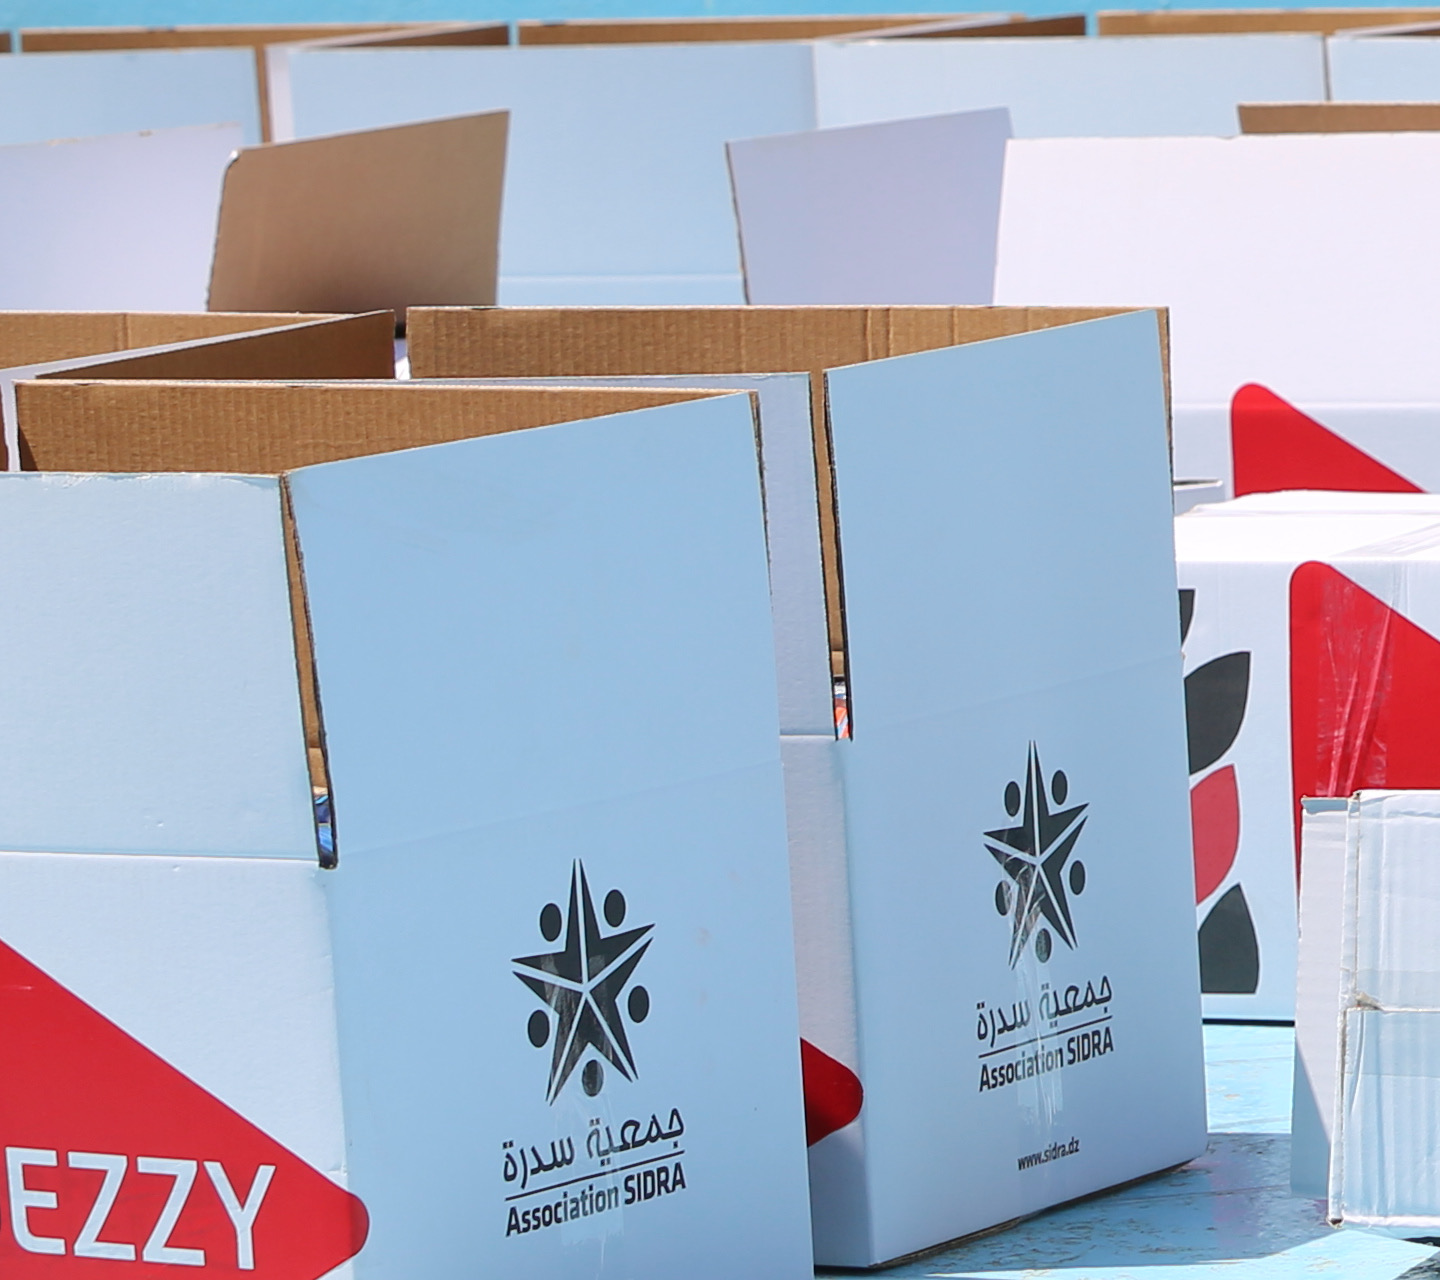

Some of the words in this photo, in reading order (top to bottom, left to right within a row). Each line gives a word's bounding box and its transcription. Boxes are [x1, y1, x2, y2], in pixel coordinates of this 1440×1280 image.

[976, 1001, 1031, 1048] سدرة
[1038, 975, 1113, 1028] جمعية
[978, 1044, 1065, 1093] Association
[1066, 1026, 1114, 1067] SIDRA
[502, 1135, 576, 1190] سدرة
[586, 1107, 685, 1167] جمعية
[1016, 1136, 1081, 1171] www.sidra.dz
[5, 1146, 277, 1271] EZZY
[505, 1183, 620, 1237] Association
[623, 1161, 687, 1206] SIDRA
